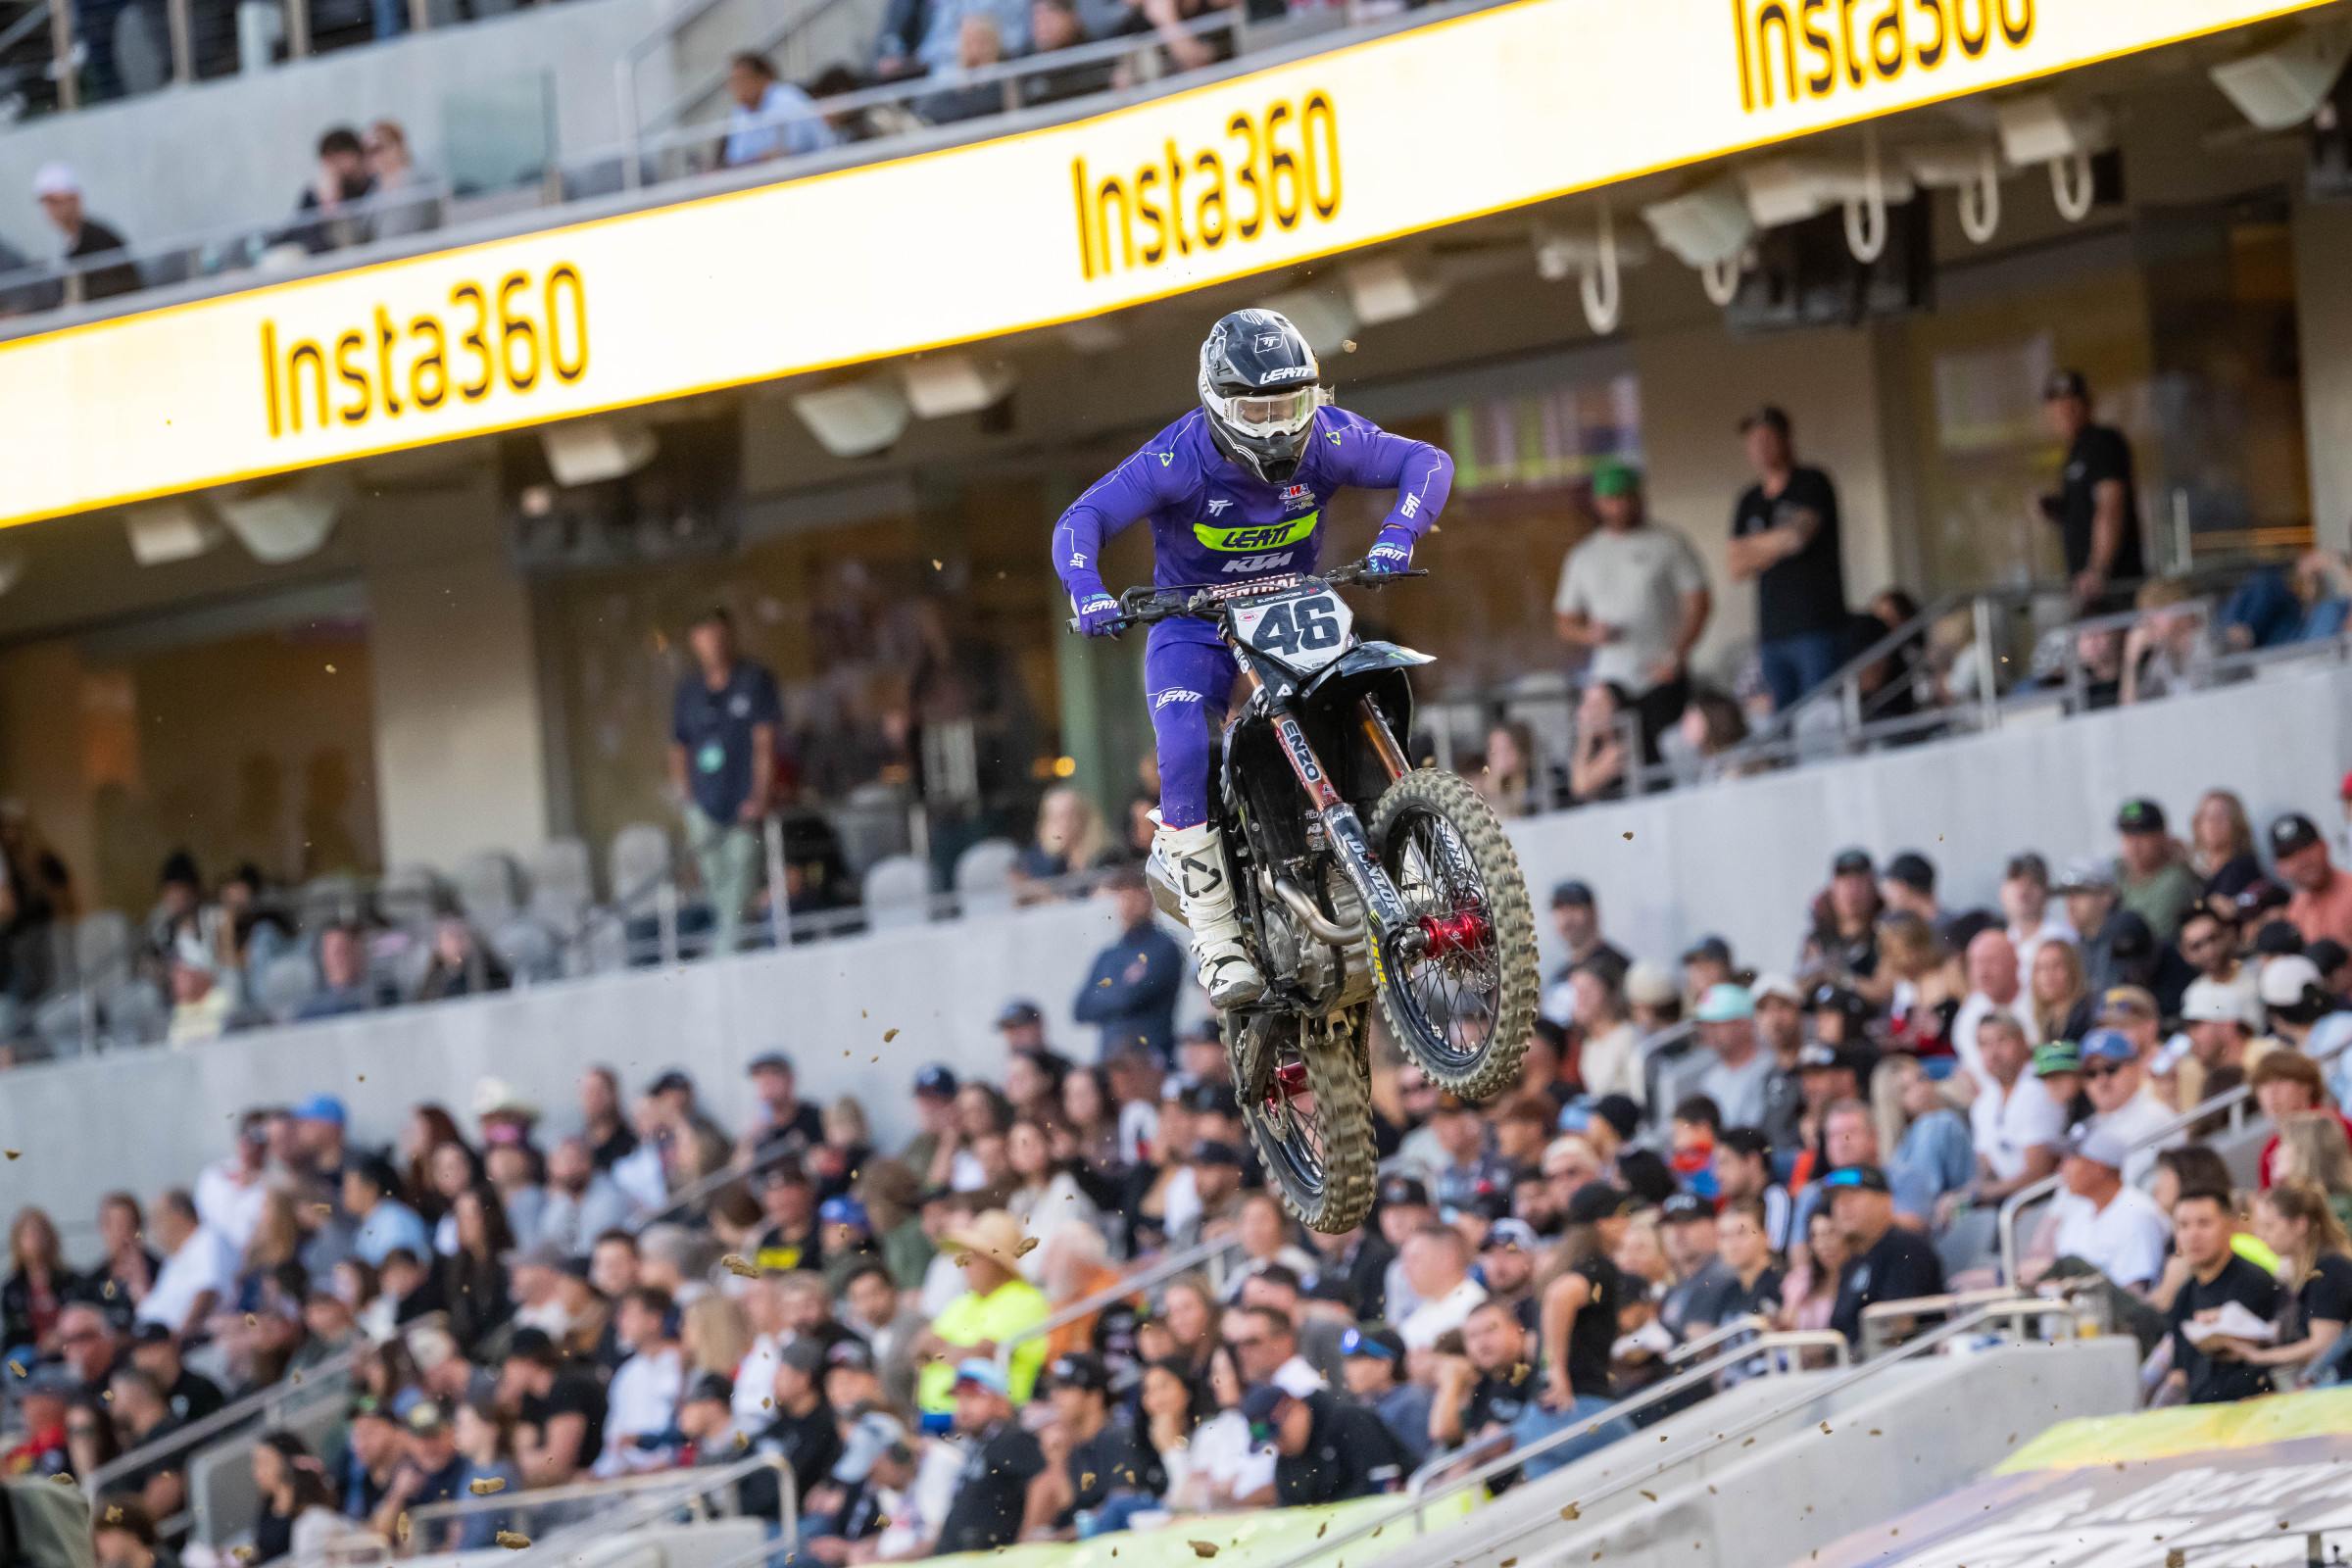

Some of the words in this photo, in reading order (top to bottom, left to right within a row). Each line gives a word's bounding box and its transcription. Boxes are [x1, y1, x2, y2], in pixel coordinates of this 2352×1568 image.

[1070, 87, 1343, 281] Insta360
[261, 260, 589, 439] Insta360
[1259, 368, 1310, 385] LEATT
[1221, 522, 1298, 549] LEATT
[1221, 552, 1294, 572] KTM
[1081, 600, 1118, 615] LEATT
[1256, 591, 1302, 604] SUPERCROSS
[1251, 596, 1342, 657] 46
[1155, 690, 1203, 709] LEATT
[1282, 720, 1320, 781] ENZO
